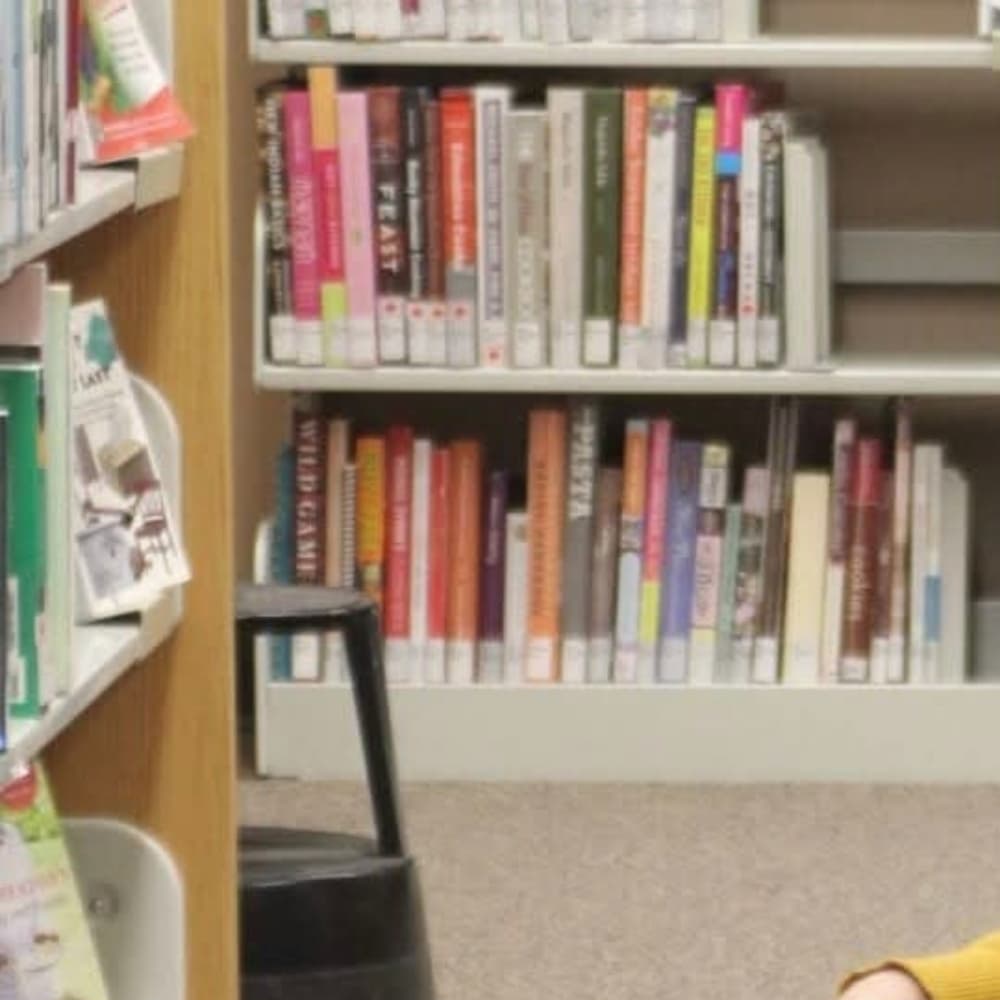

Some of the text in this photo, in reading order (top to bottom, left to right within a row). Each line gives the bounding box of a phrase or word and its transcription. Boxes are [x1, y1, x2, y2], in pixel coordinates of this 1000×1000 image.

[377, 184, 399, 273] FEAST
[296, 418, 319, 580] WILD GAME
[569, 423, 596, 519] PASTA
